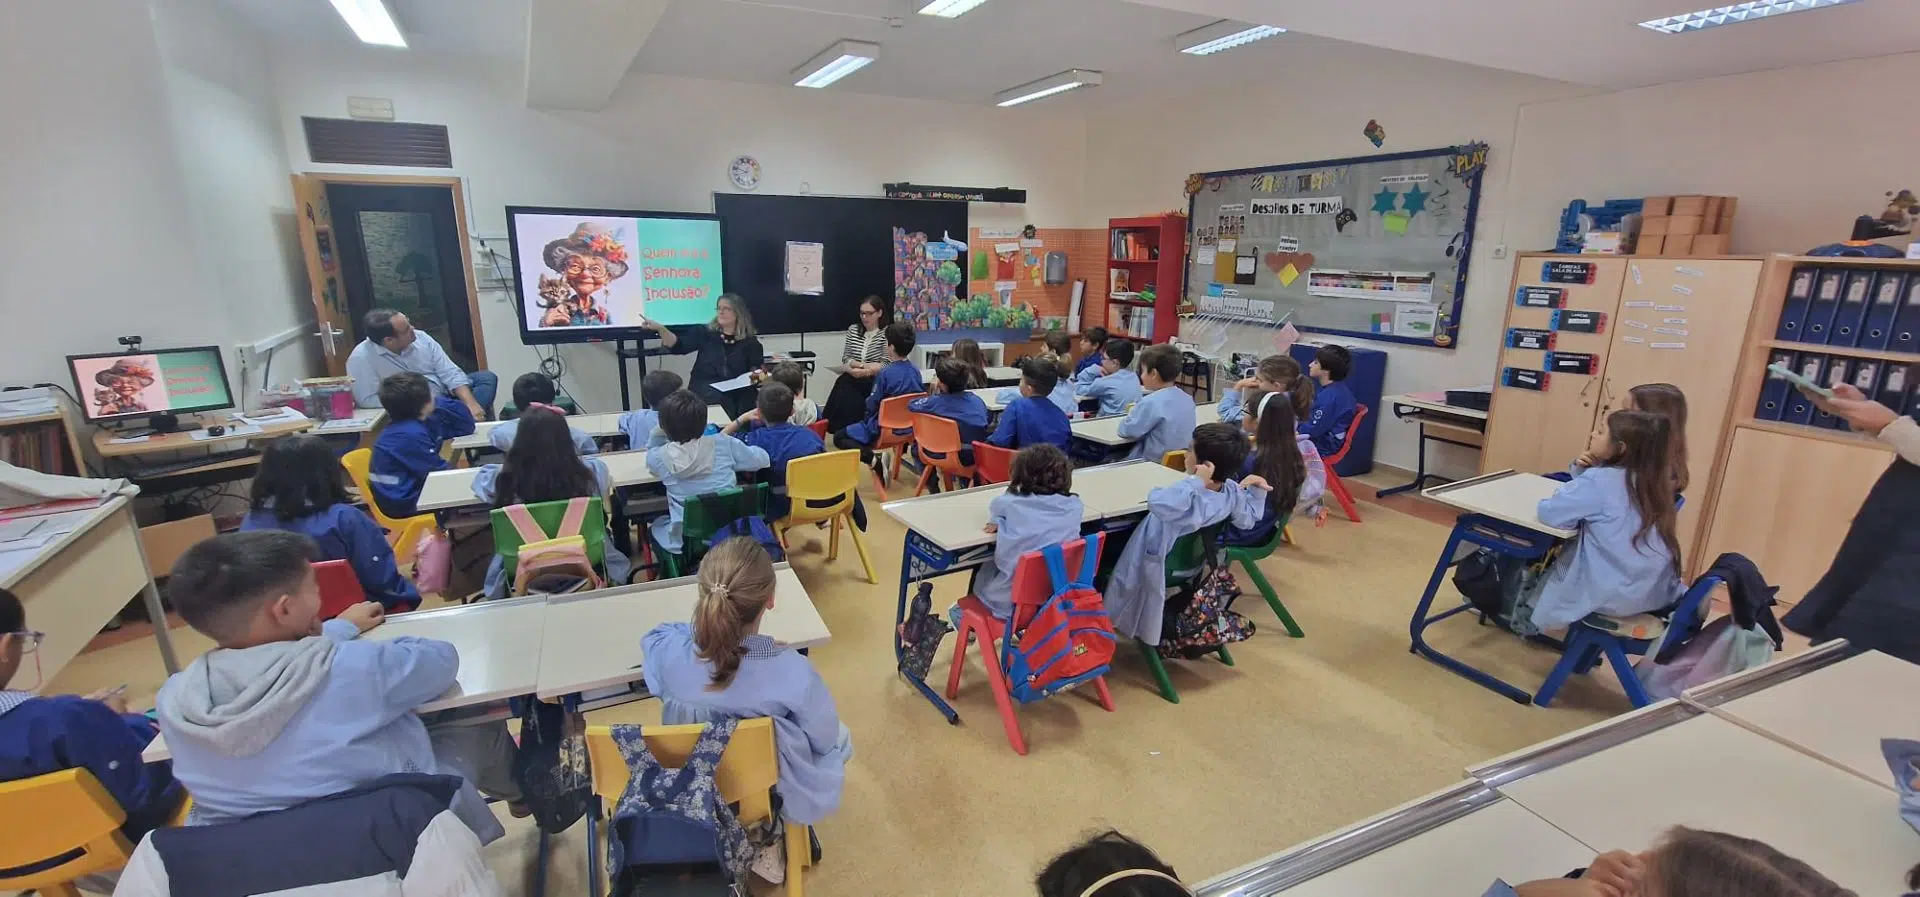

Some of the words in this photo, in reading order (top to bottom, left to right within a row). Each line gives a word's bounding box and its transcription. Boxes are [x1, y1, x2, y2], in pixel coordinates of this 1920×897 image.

[1456, 150, 1485, 174] PLAY
[1292, 203, 1305, 214] DE
[1309, 201, 1342, 214] TURMA
[643, 248, 676, 260] Quem
[644, 267, 701, 281] Senhora
[645, 285, 710, 301] Inclusão?
